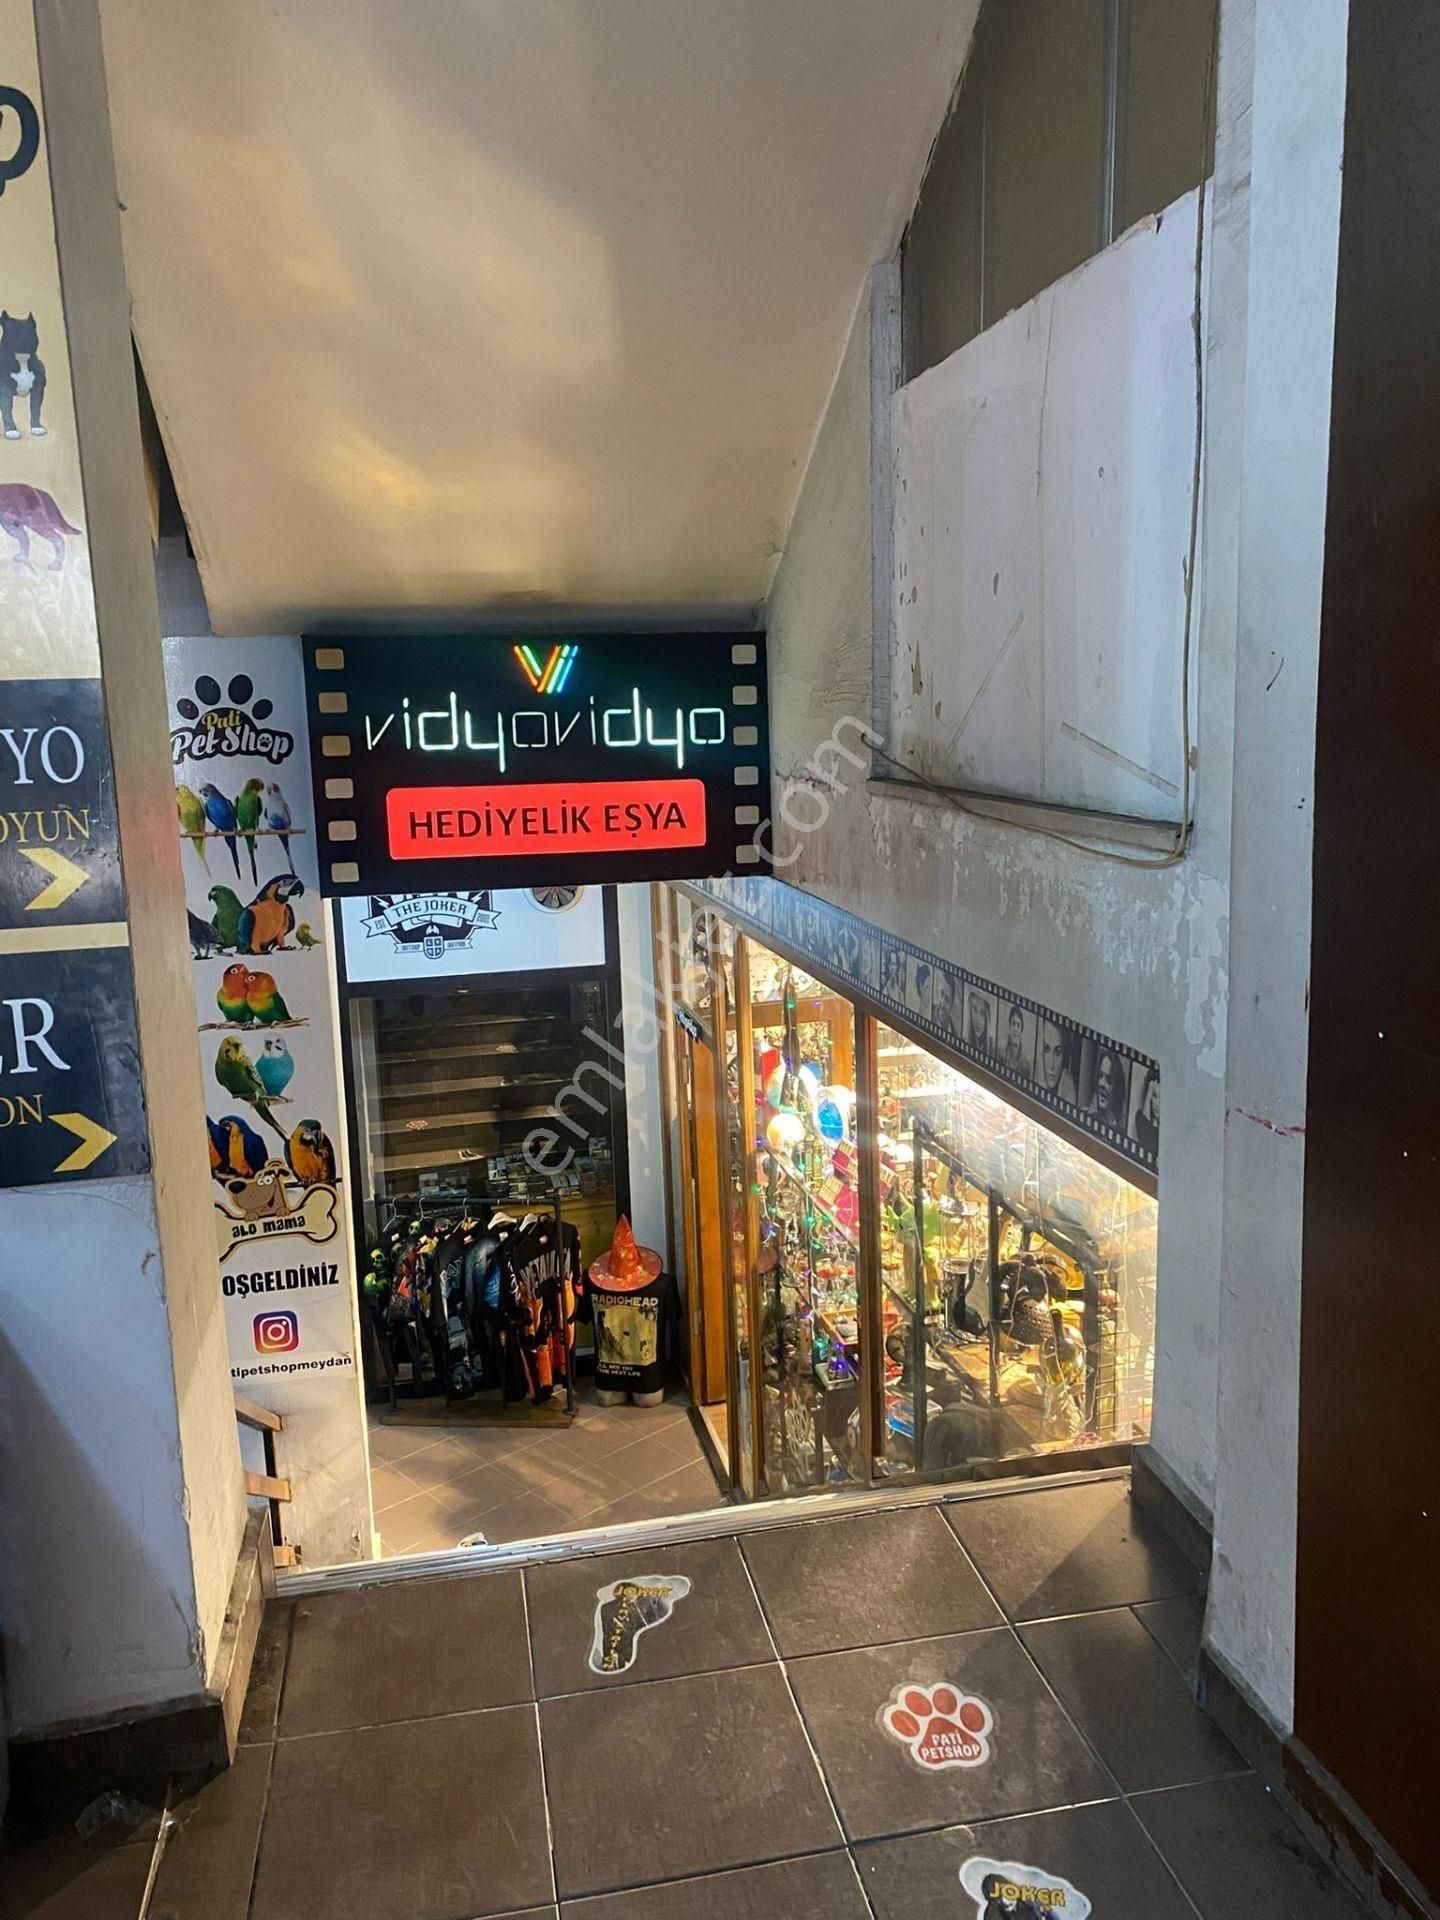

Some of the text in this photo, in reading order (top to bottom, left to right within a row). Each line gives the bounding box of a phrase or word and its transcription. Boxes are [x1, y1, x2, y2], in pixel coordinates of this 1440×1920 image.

[202, 710, 242, 730] Pati
[365, 687, 725, 773] vidyovidyo
[170, 723, 290, 760] Pet Shop
[409, 800, 687, 840] HEDİYELİK EŞYA
[392, 900, 468, 918] THE JOKER
[0, 998, 71, 1074] R
[263, 1215, 306, 1233] mama
[591, 1293, 659, 1307] RADIOHEAD
[231, 1356, 352, 1379] tipetshopmeydan
[614, 1586, 669, 1598] JOKER
[931, 1729, 963, 1746] PATİ
[921, 1744, 980, 1760] PETSHOP
[989, 1882, 1066, 1907] JOKER
